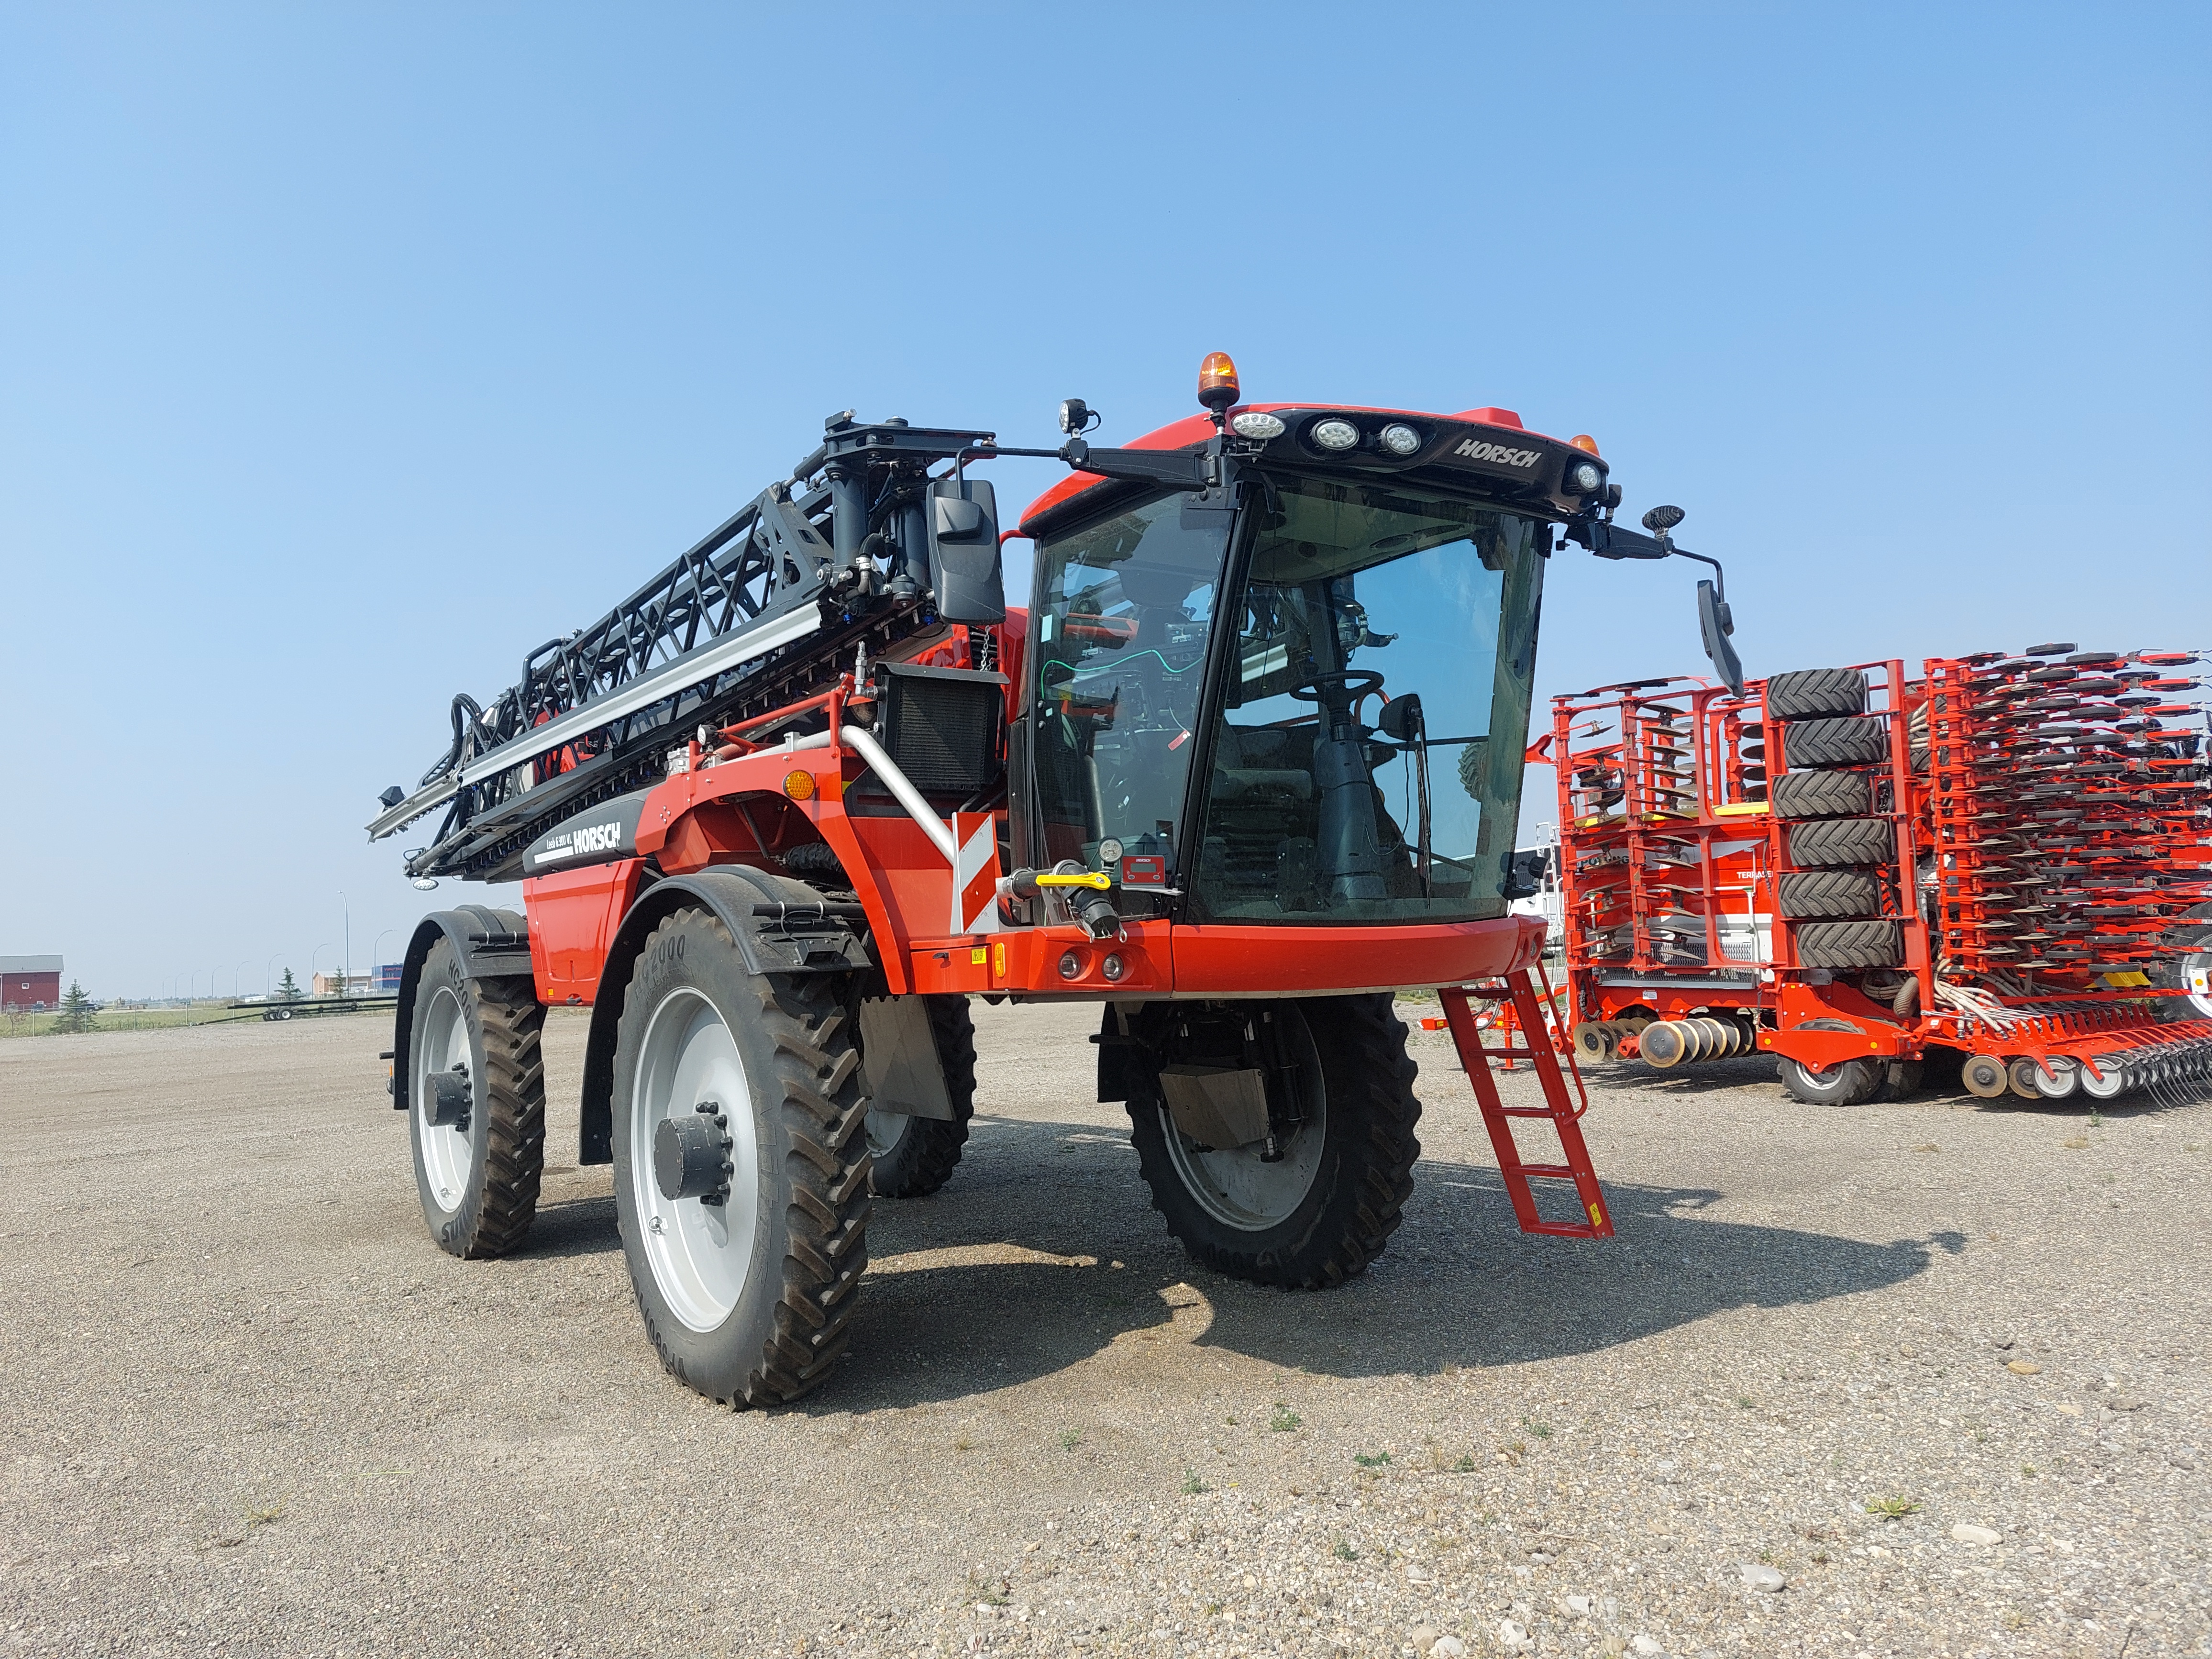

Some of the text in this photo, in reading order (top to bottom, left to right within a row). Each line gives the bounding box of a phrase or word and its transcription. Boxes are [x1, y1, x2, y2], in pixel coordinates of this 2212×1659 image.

[1453, 439, 1542, 467] HORSCH
[546, 837, 555, 850] Leeb
[574, 822, 620, 854] HORSCH
[448, 958, 475, 1037] HC2000
